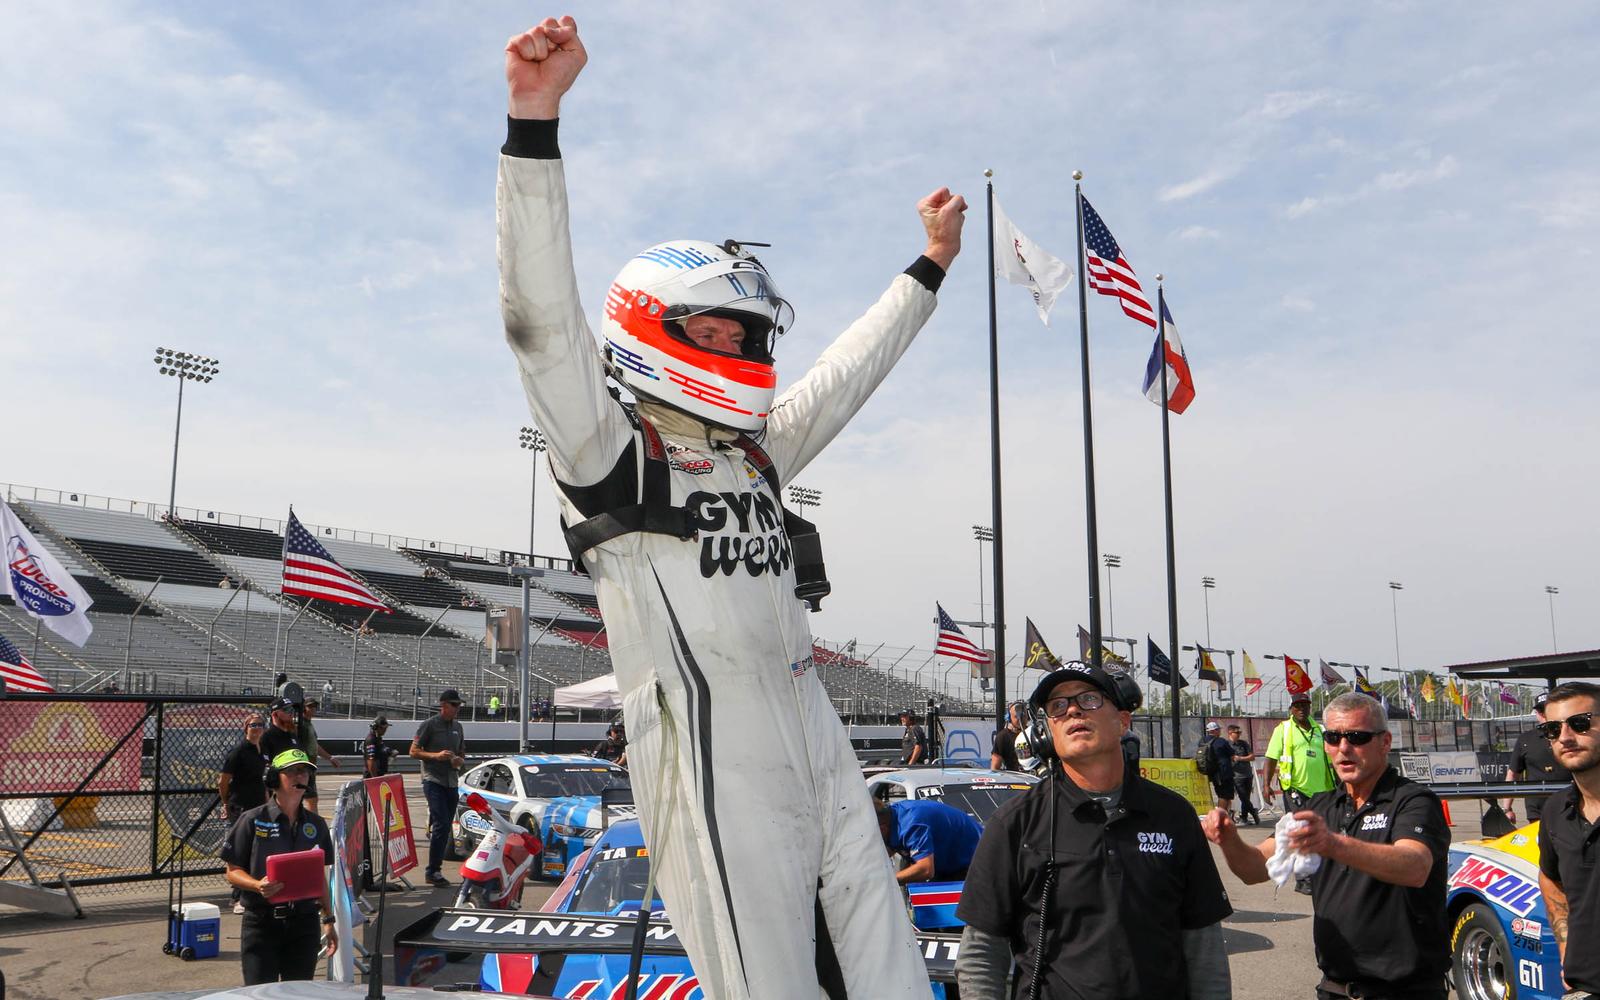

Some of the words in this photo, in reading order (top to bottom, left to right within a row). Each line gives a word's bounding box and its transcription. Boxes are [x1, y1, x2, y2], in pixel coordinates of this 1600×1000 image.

[685, 491, 781, 533] GYM
[20, 580, 72, 612] PRODUCTS
[1435, 767, 1475, 777] BENNETT
[920, 788, 941, 798] TA
[1361, 816, 1388, 830] weed
[1137, 831, 1168, 844] GYM
[602, 847, 627, 861] TA
[1138, 838, 1173, 855] weed
[1452, 857, 1540, 913] AMSOIL
[448, 916, 618, 938] PLANTS
[1519, 958, 1544, 991] GT1
